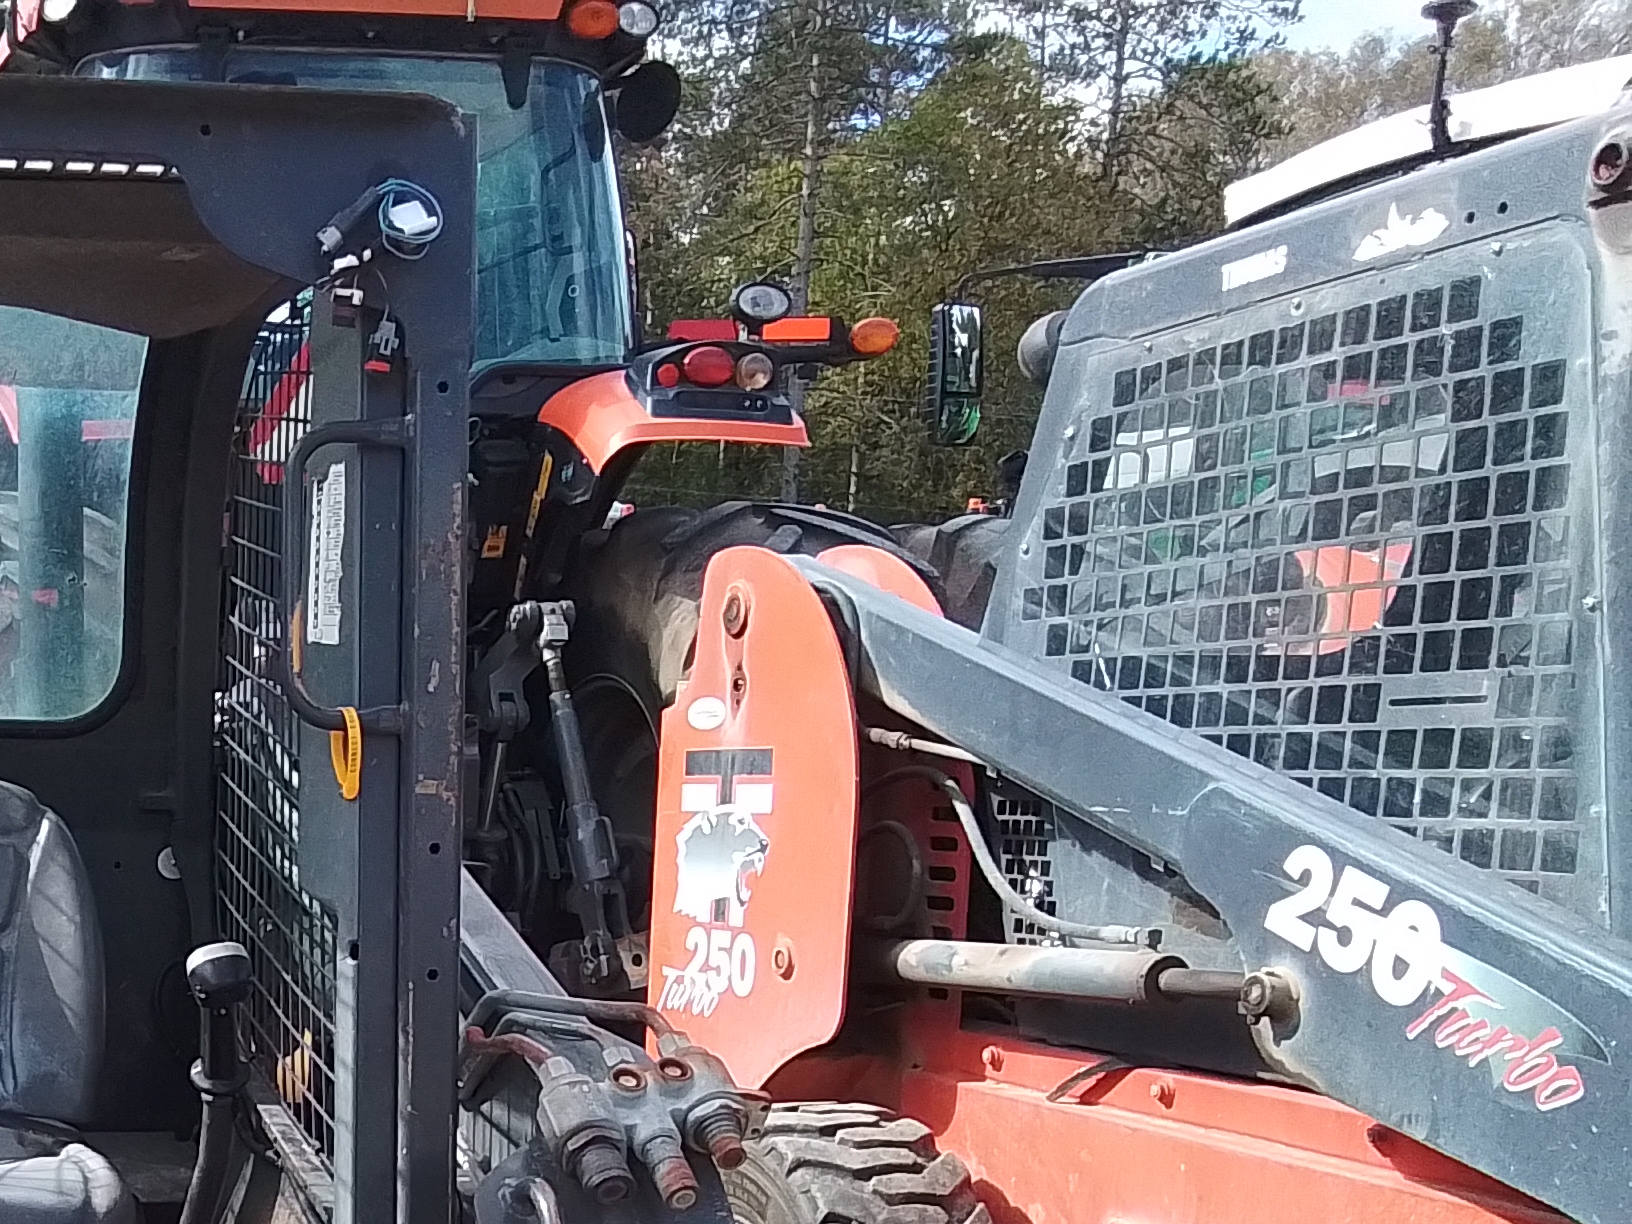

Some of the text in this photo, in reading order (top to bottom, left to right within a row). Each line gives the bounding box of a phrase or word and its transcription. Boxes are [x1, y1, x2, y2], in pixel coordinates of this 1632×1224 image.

[684, 925, 756, 998] 250
[1263, 843, 1442, 1007] 250
[656, 964, 720, 1018] Turbo
[1404, 964, 1586, 1112] Turbo
